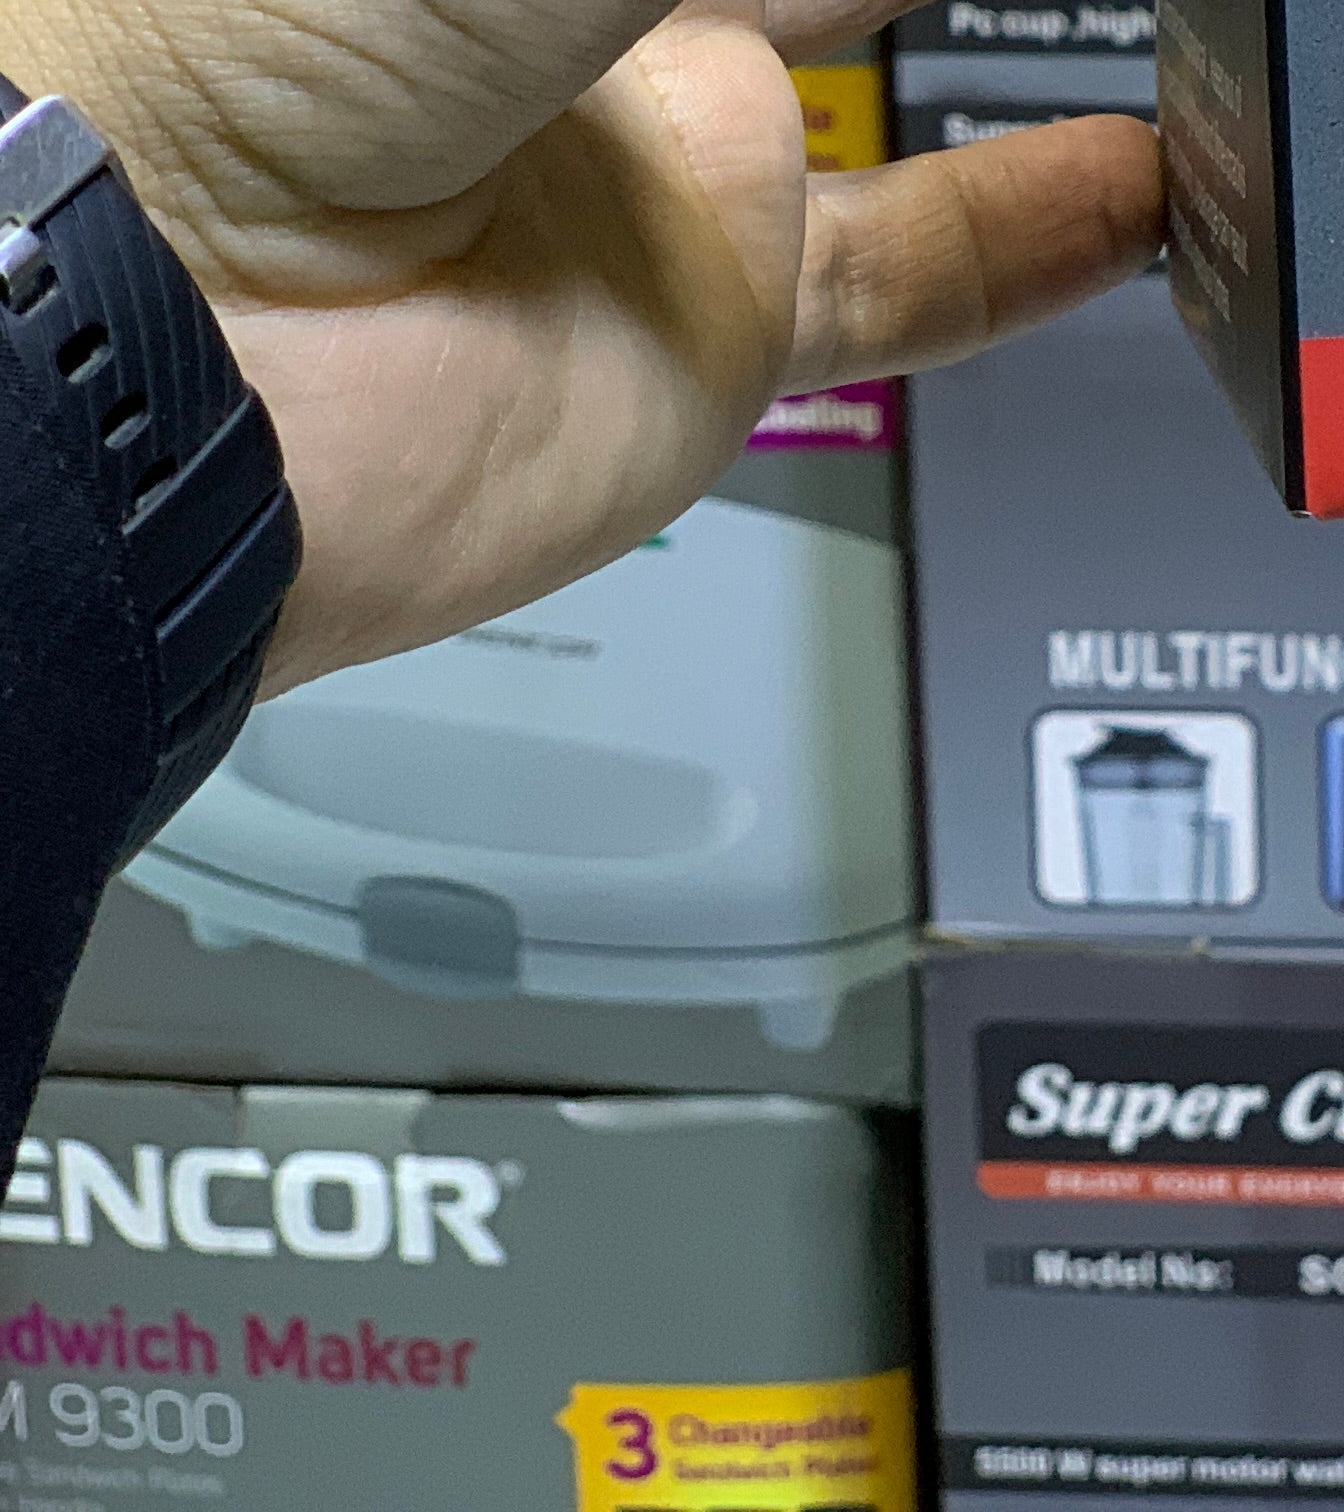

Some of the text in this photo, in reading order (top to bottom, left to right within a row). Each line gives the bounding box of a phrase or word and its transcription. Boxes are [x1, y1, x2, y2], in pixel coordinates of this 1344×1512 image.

[1006, 1061, 1268, 1155] Super
[1032, 1248, 1156, 1290] Model
[0, 1301, 476, 1389] dwich Maker
[50, 1383, 245, 1458] 9300
[606, 1407, 658, 1482] 3
